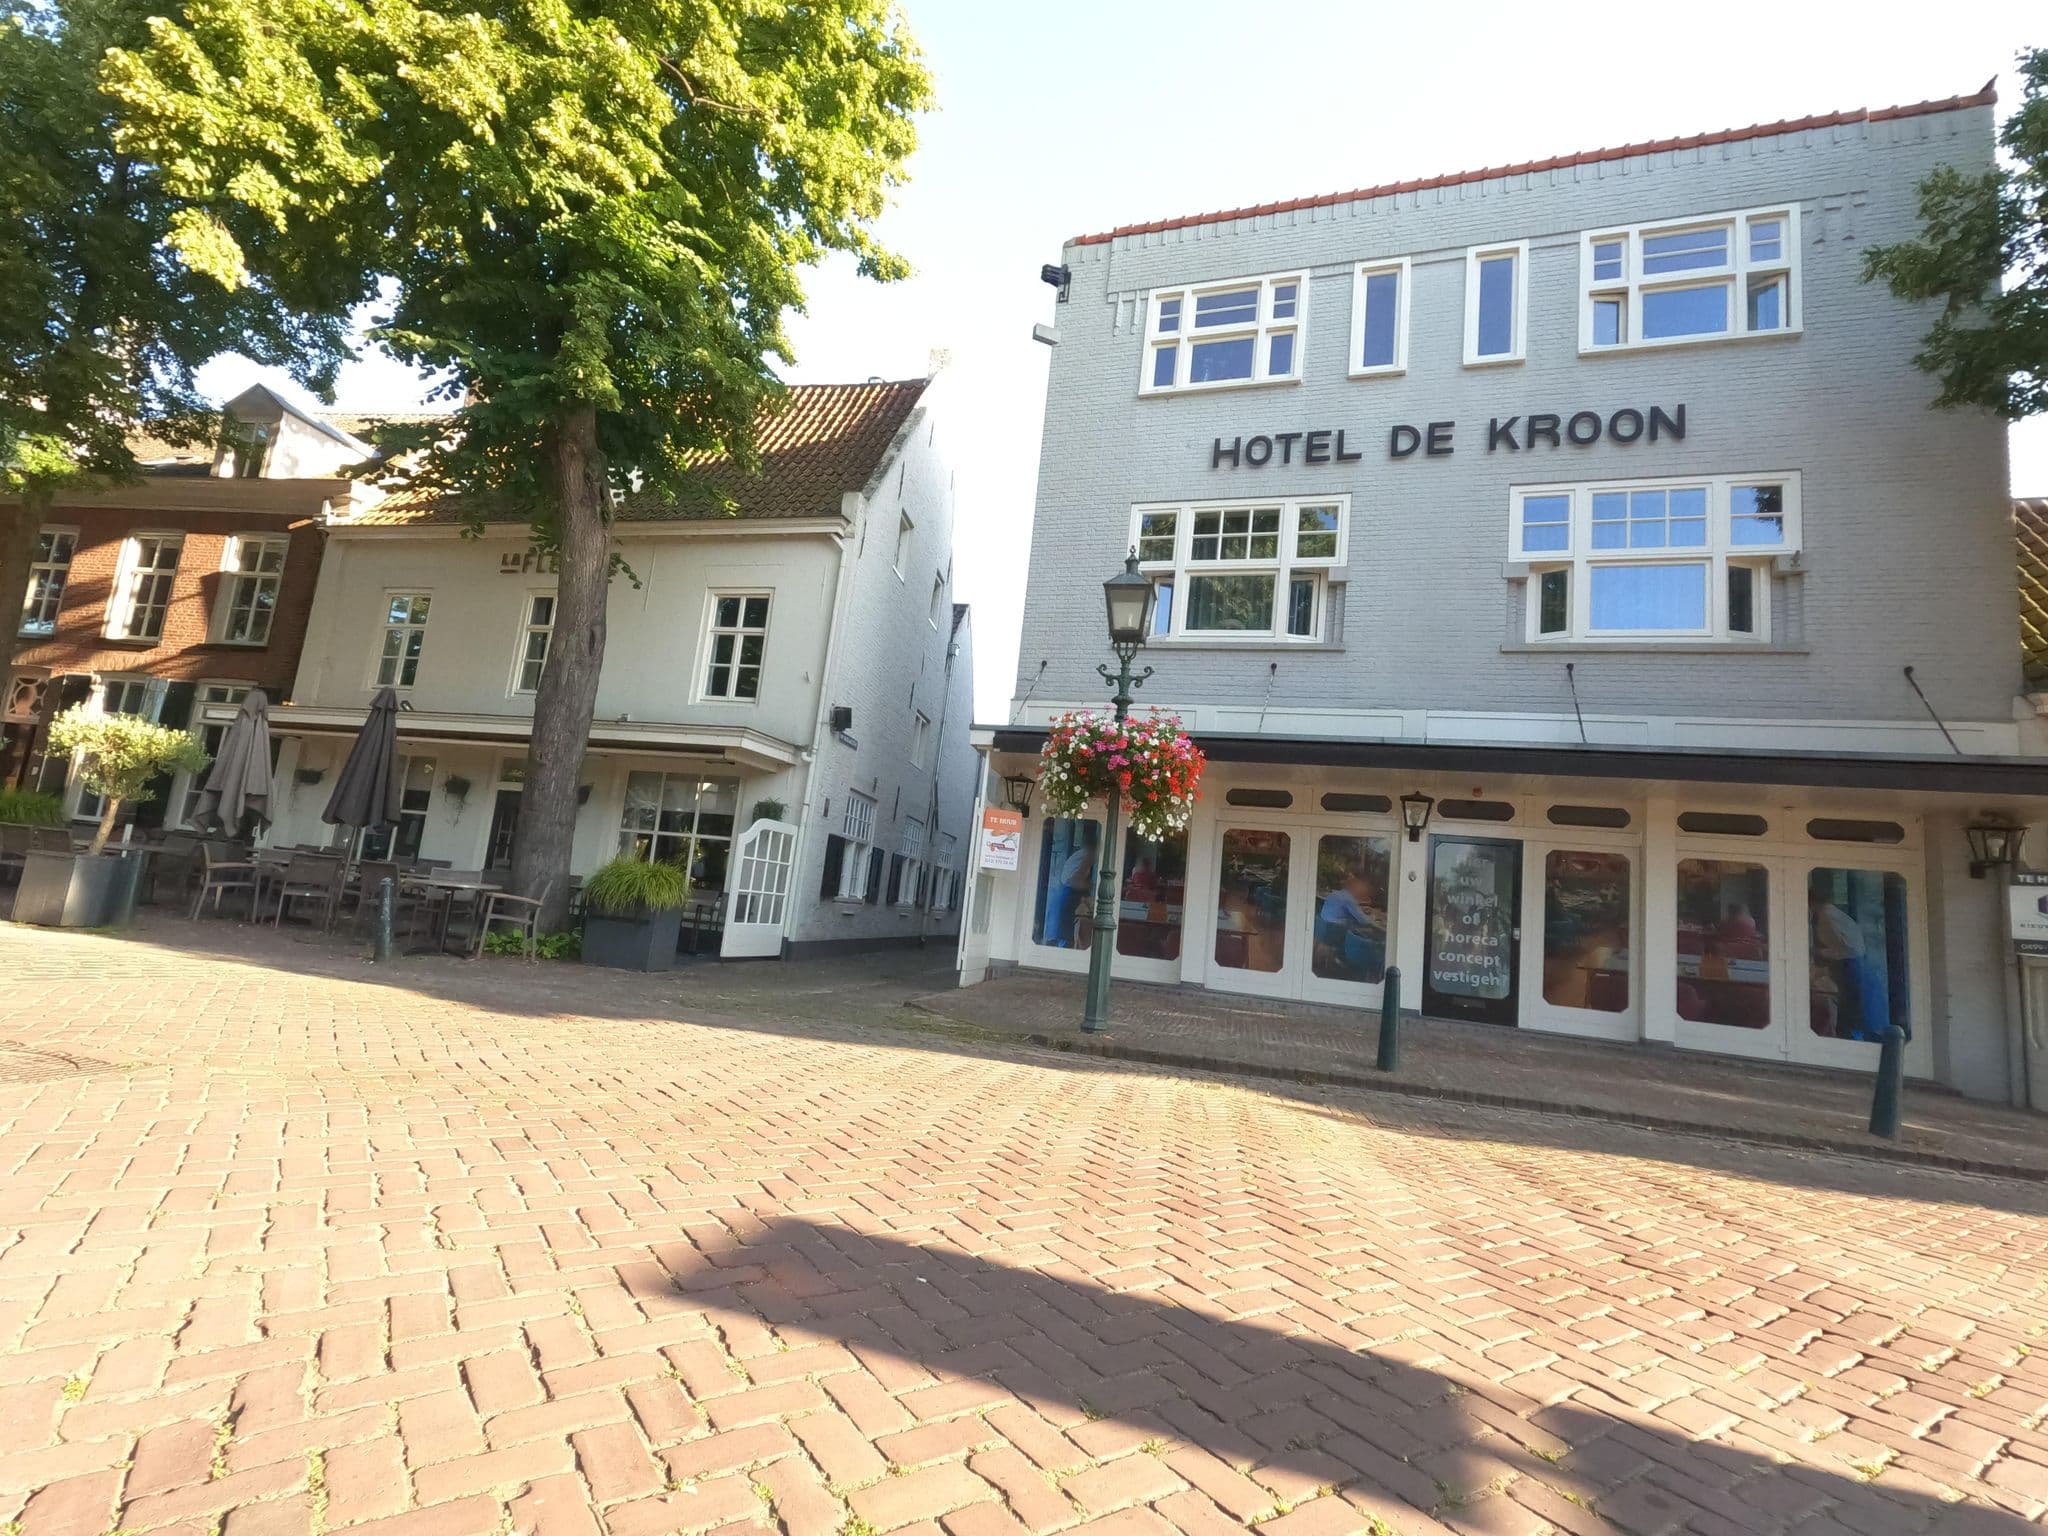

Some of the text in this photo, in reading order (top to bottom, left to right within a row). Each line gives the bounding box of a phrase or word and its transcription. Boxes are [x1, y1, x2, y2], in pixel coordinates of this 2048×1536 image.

[1212, 403, 1686, 469] HOTEL DE KROON
[989, 816, 998, 824] TE
[1460, 876, 1482, 887] uw
[2018, 874, 2035, 883] TE
[1447, 893, 1498, 907] winkel
[1462, 912, 1482, 926] of
[1444, 931, 1499, 947] horeca
[1438, 951, 1501, 969] concept
